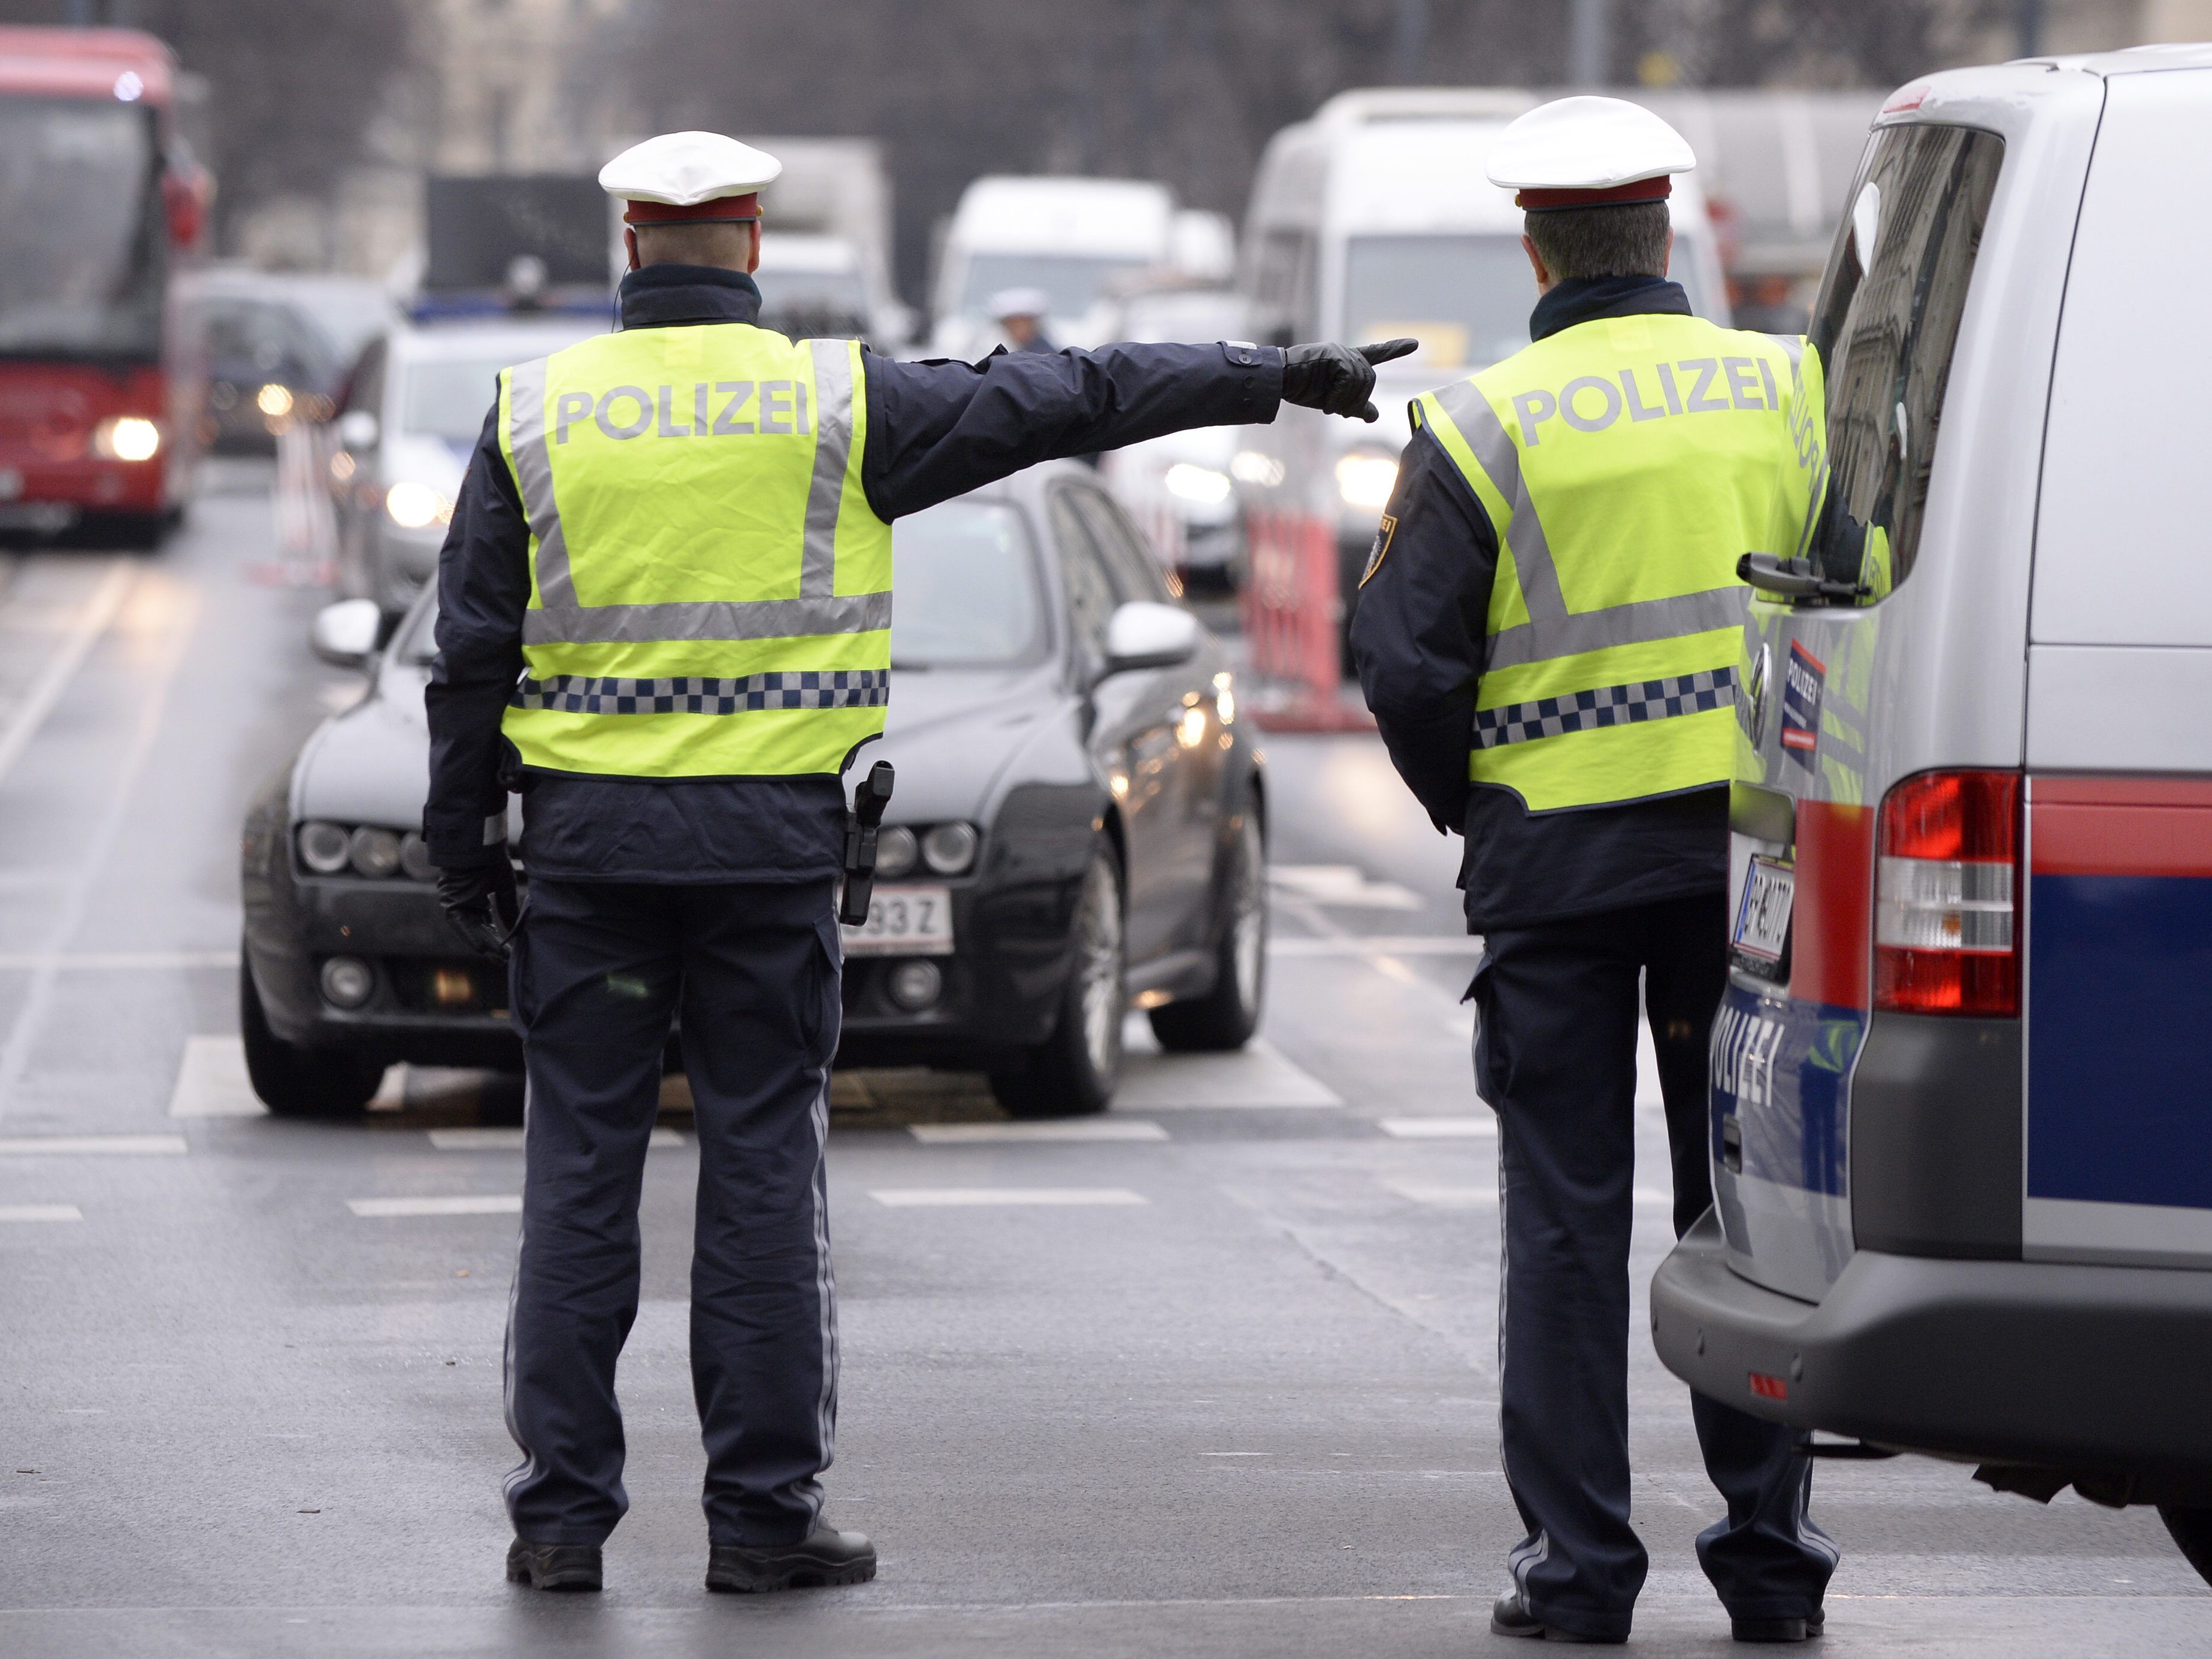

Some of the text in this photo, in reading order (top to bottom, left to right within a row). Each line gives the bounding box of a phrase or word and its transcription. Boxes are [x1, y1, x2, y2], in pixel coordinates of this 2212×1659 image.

[556, 380, 810, 445] POLIZEI
[1512, 357, 1779, 447] POLIZEI
[1788, 658, 1818, 706] POLIZEI
